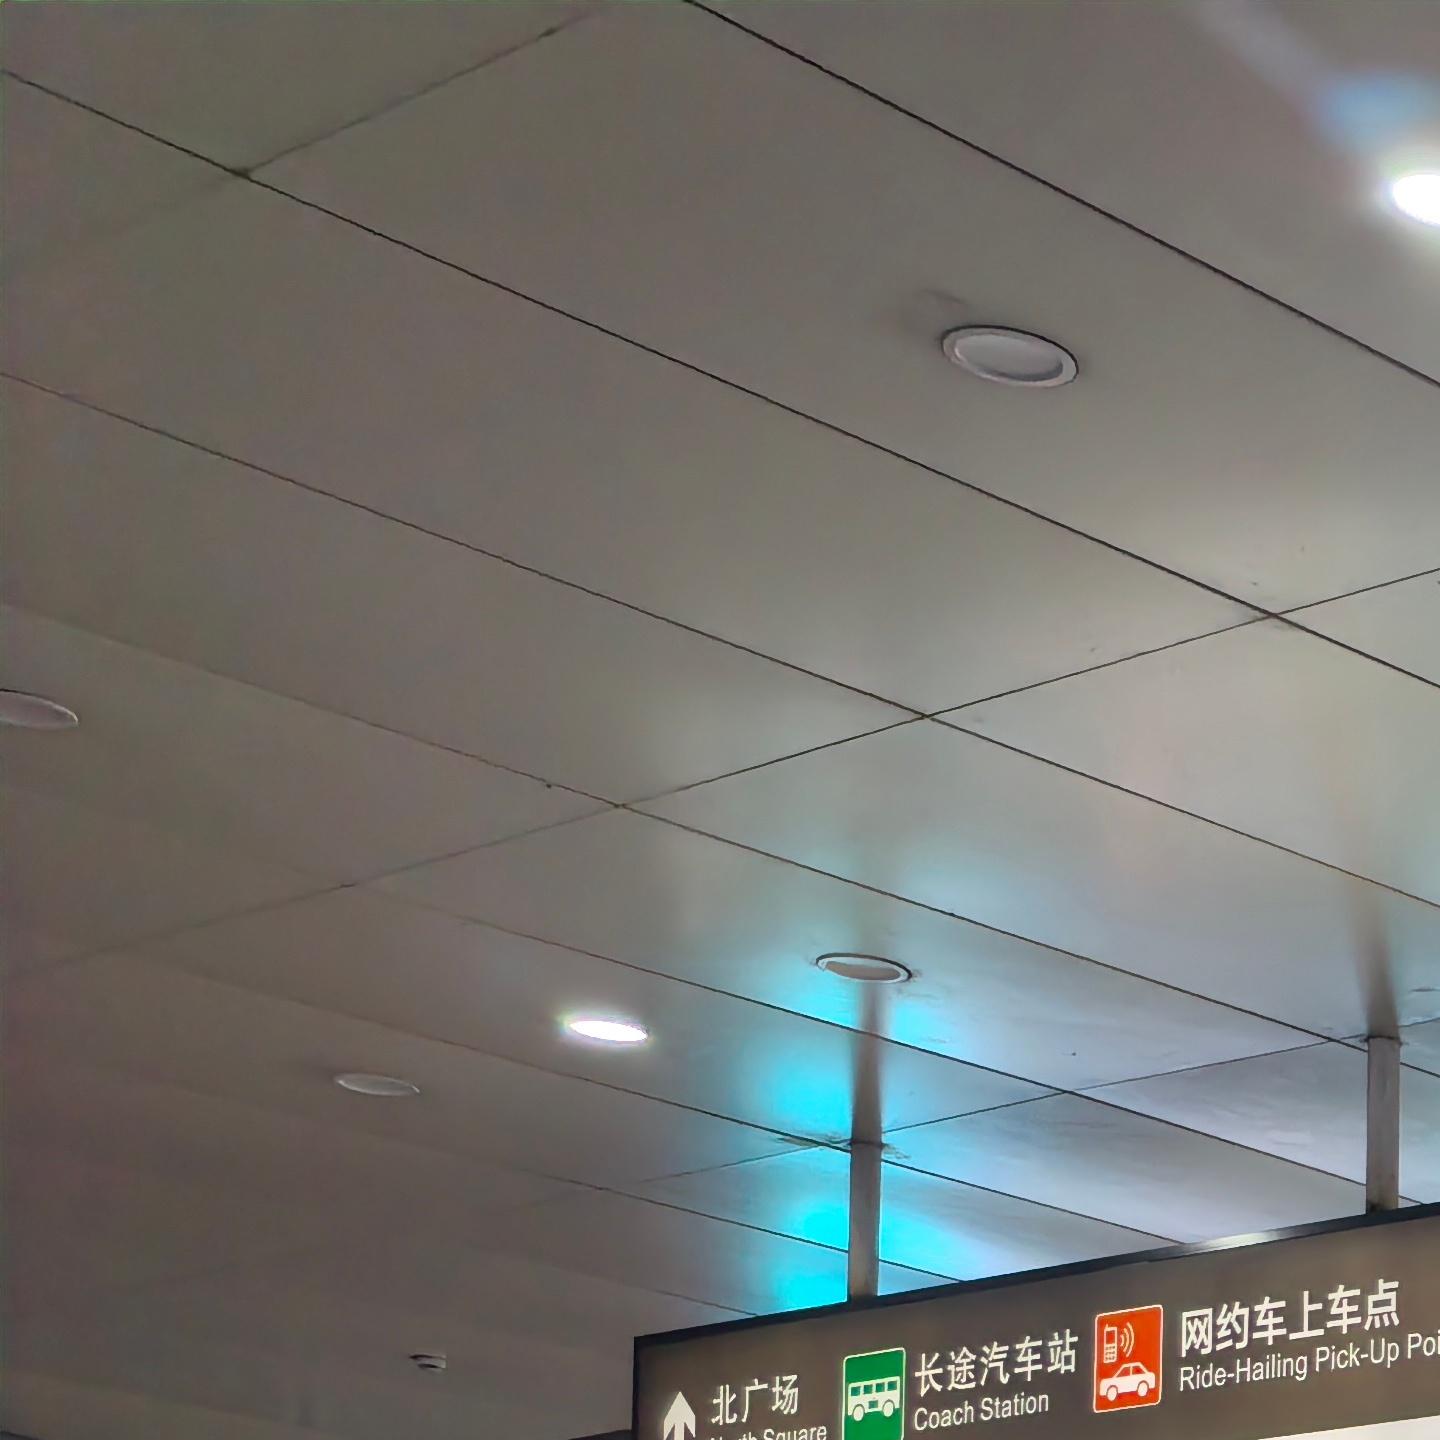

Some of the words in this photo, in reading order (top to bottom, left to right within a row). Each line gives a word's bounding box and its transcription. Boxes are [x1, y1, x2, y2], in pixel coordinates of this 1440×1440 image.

[1180, 1278, 1400, 1358] 网约车上车点
[914, 1328, 1080, 1398] 长途汽车站
[1179, 1353, 1309, 1392] Ride-Hailing
[1315, 1337, 1400, 1373] Pick-Up
[710, 1374, 800, 1427] 北广场
[914, 1402, 975, 1432] Coach
[980, 1392, 1050, 1421] Station
